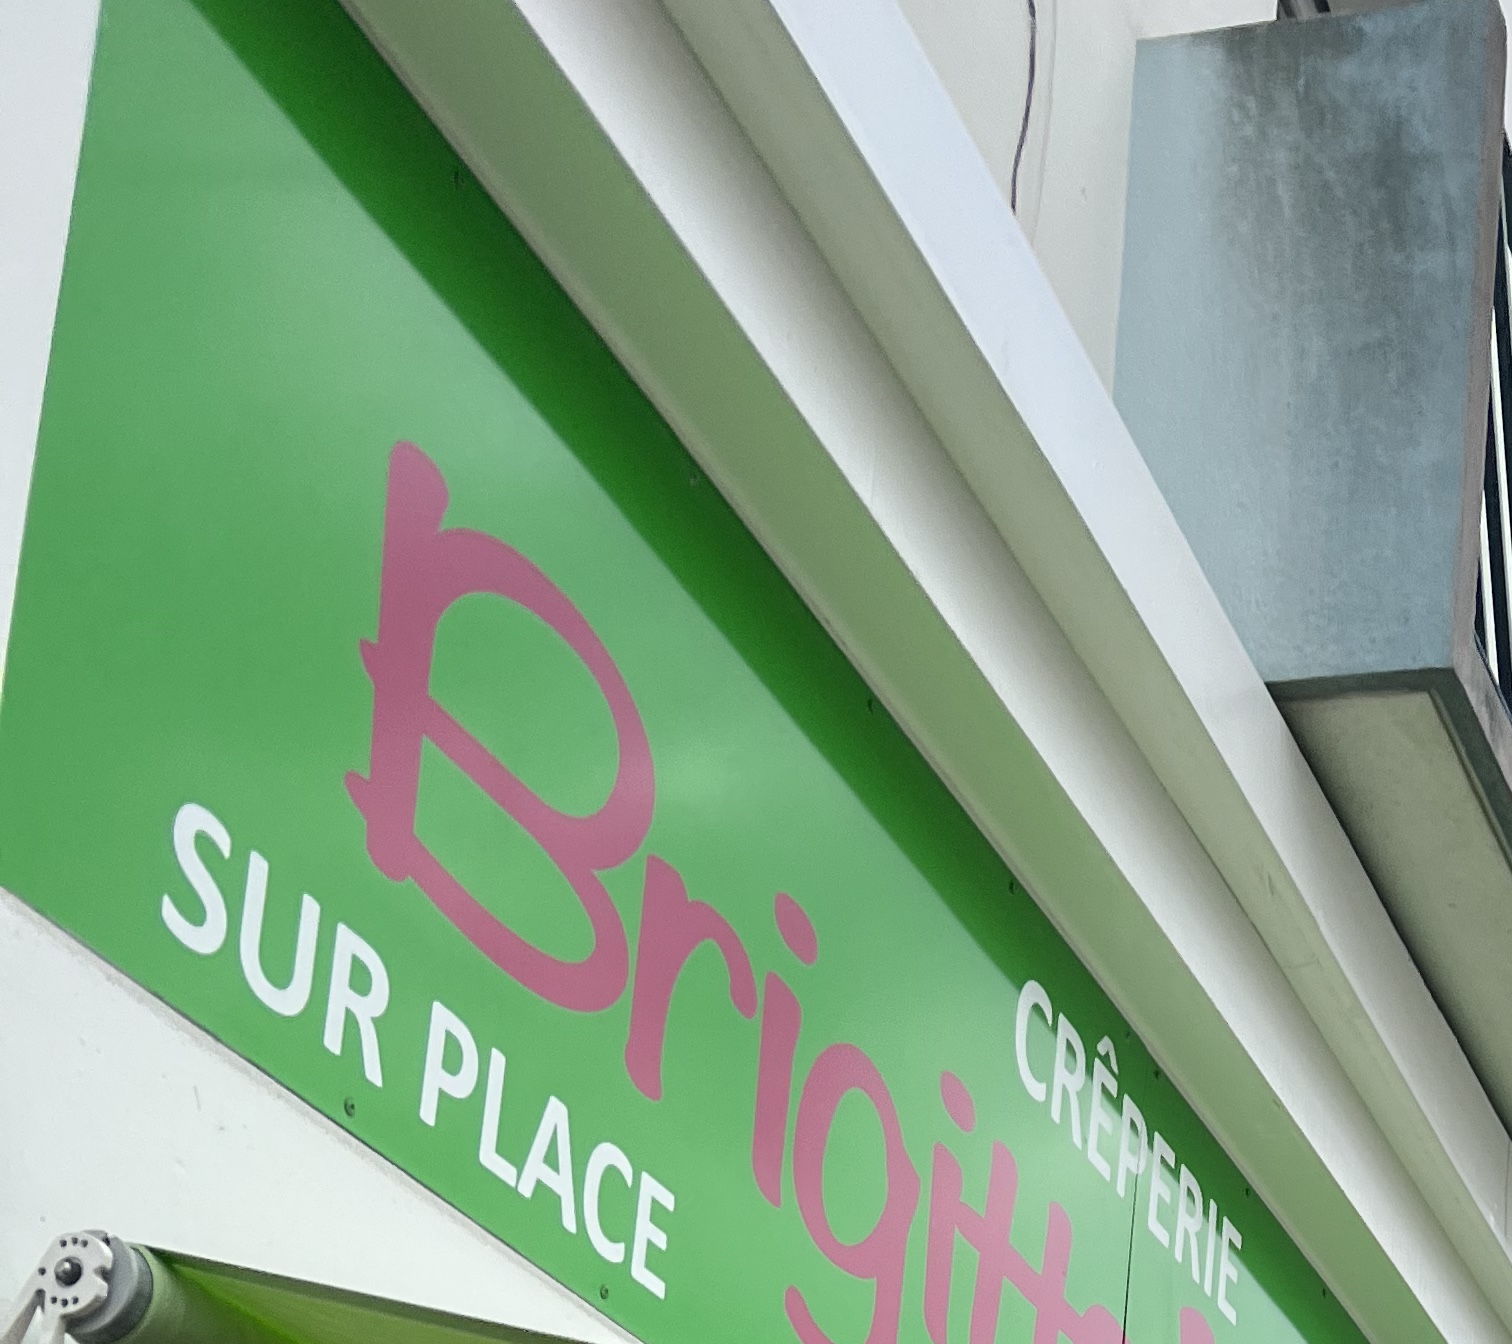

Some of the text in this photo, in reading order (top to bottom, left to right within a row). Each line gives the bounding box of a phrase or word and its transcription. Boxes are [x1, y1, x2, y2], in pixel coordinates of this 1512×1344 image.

[161, 802, 677, 1299] SUR PLACE
[1013, 979, 1244, 1326] CRÊPERIE
